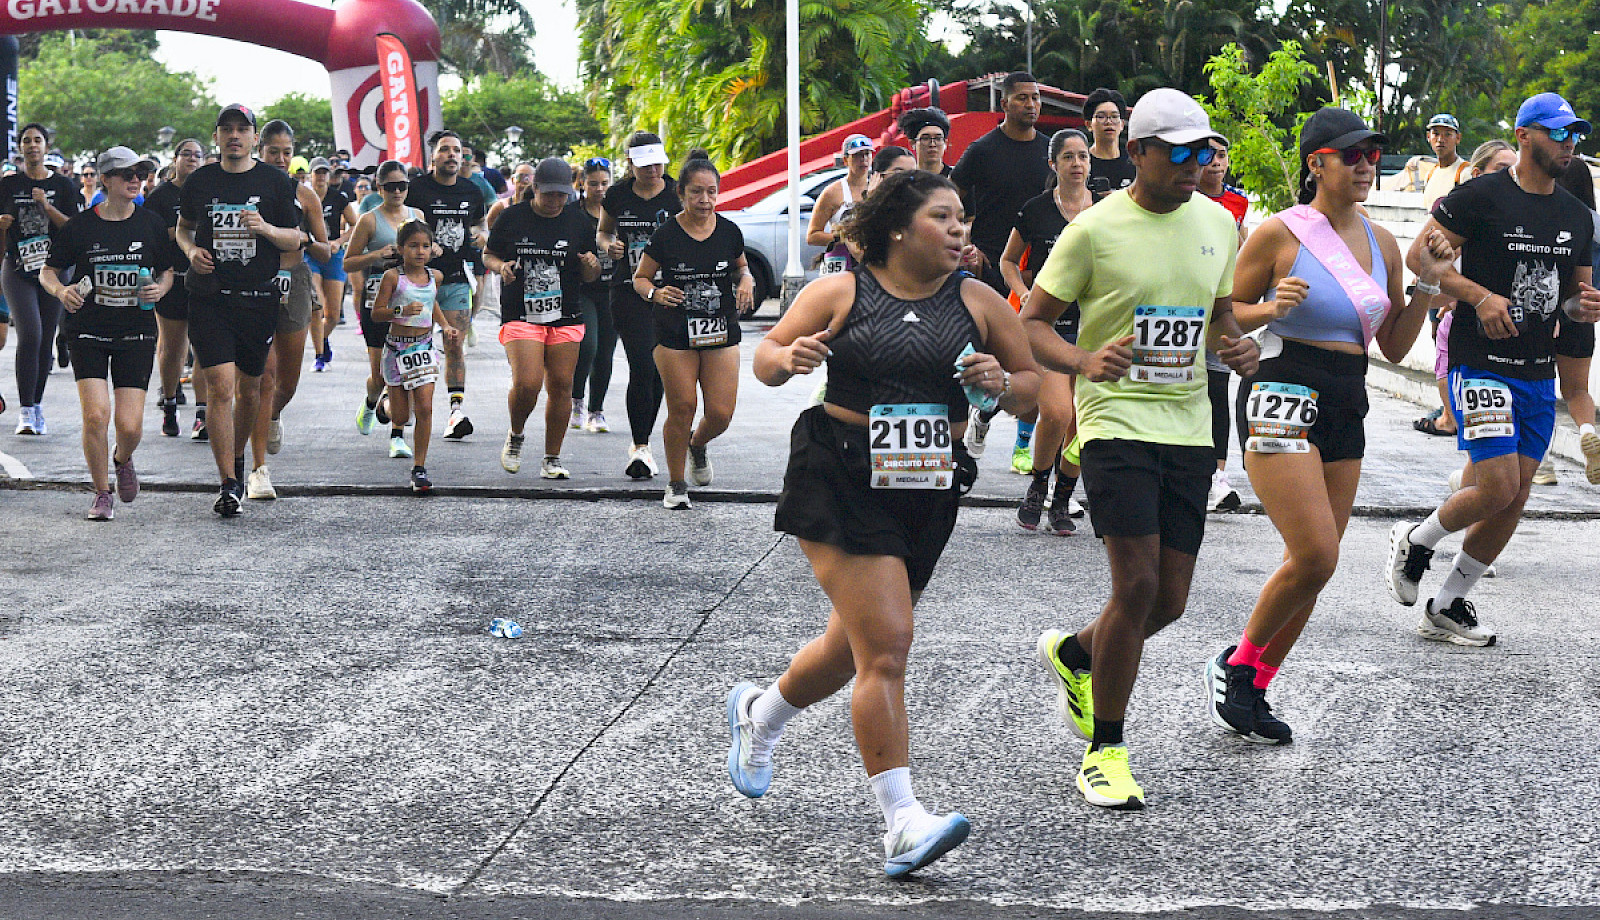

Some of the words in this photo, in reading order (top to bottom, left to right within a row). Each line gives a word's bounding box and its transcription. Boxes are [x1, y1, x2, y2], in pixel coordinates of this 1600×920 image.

[7, 0, 221, 22] GATORADE
[387, 51, 412, 168] GATOR
[88, 254, 125, 263] CIRCUITO
[126, 253, 143, 261] CITY
[551, 249, 568, 258] CITY
[1507, 242, 1552, 254] CIRCUITO
[1552, 246, 1572, 257] CITY
[96, 271, 138, 287] 1800
[525, 296, 561, 314] 1353
[1135, 319, 1204, 347] 1287
[402, 351, 432, 370] 909
[1250, 394, 1317, 424] 1276
[1466, 388, 1506, 410] 995
[871, 419, 950, 449] 2198
